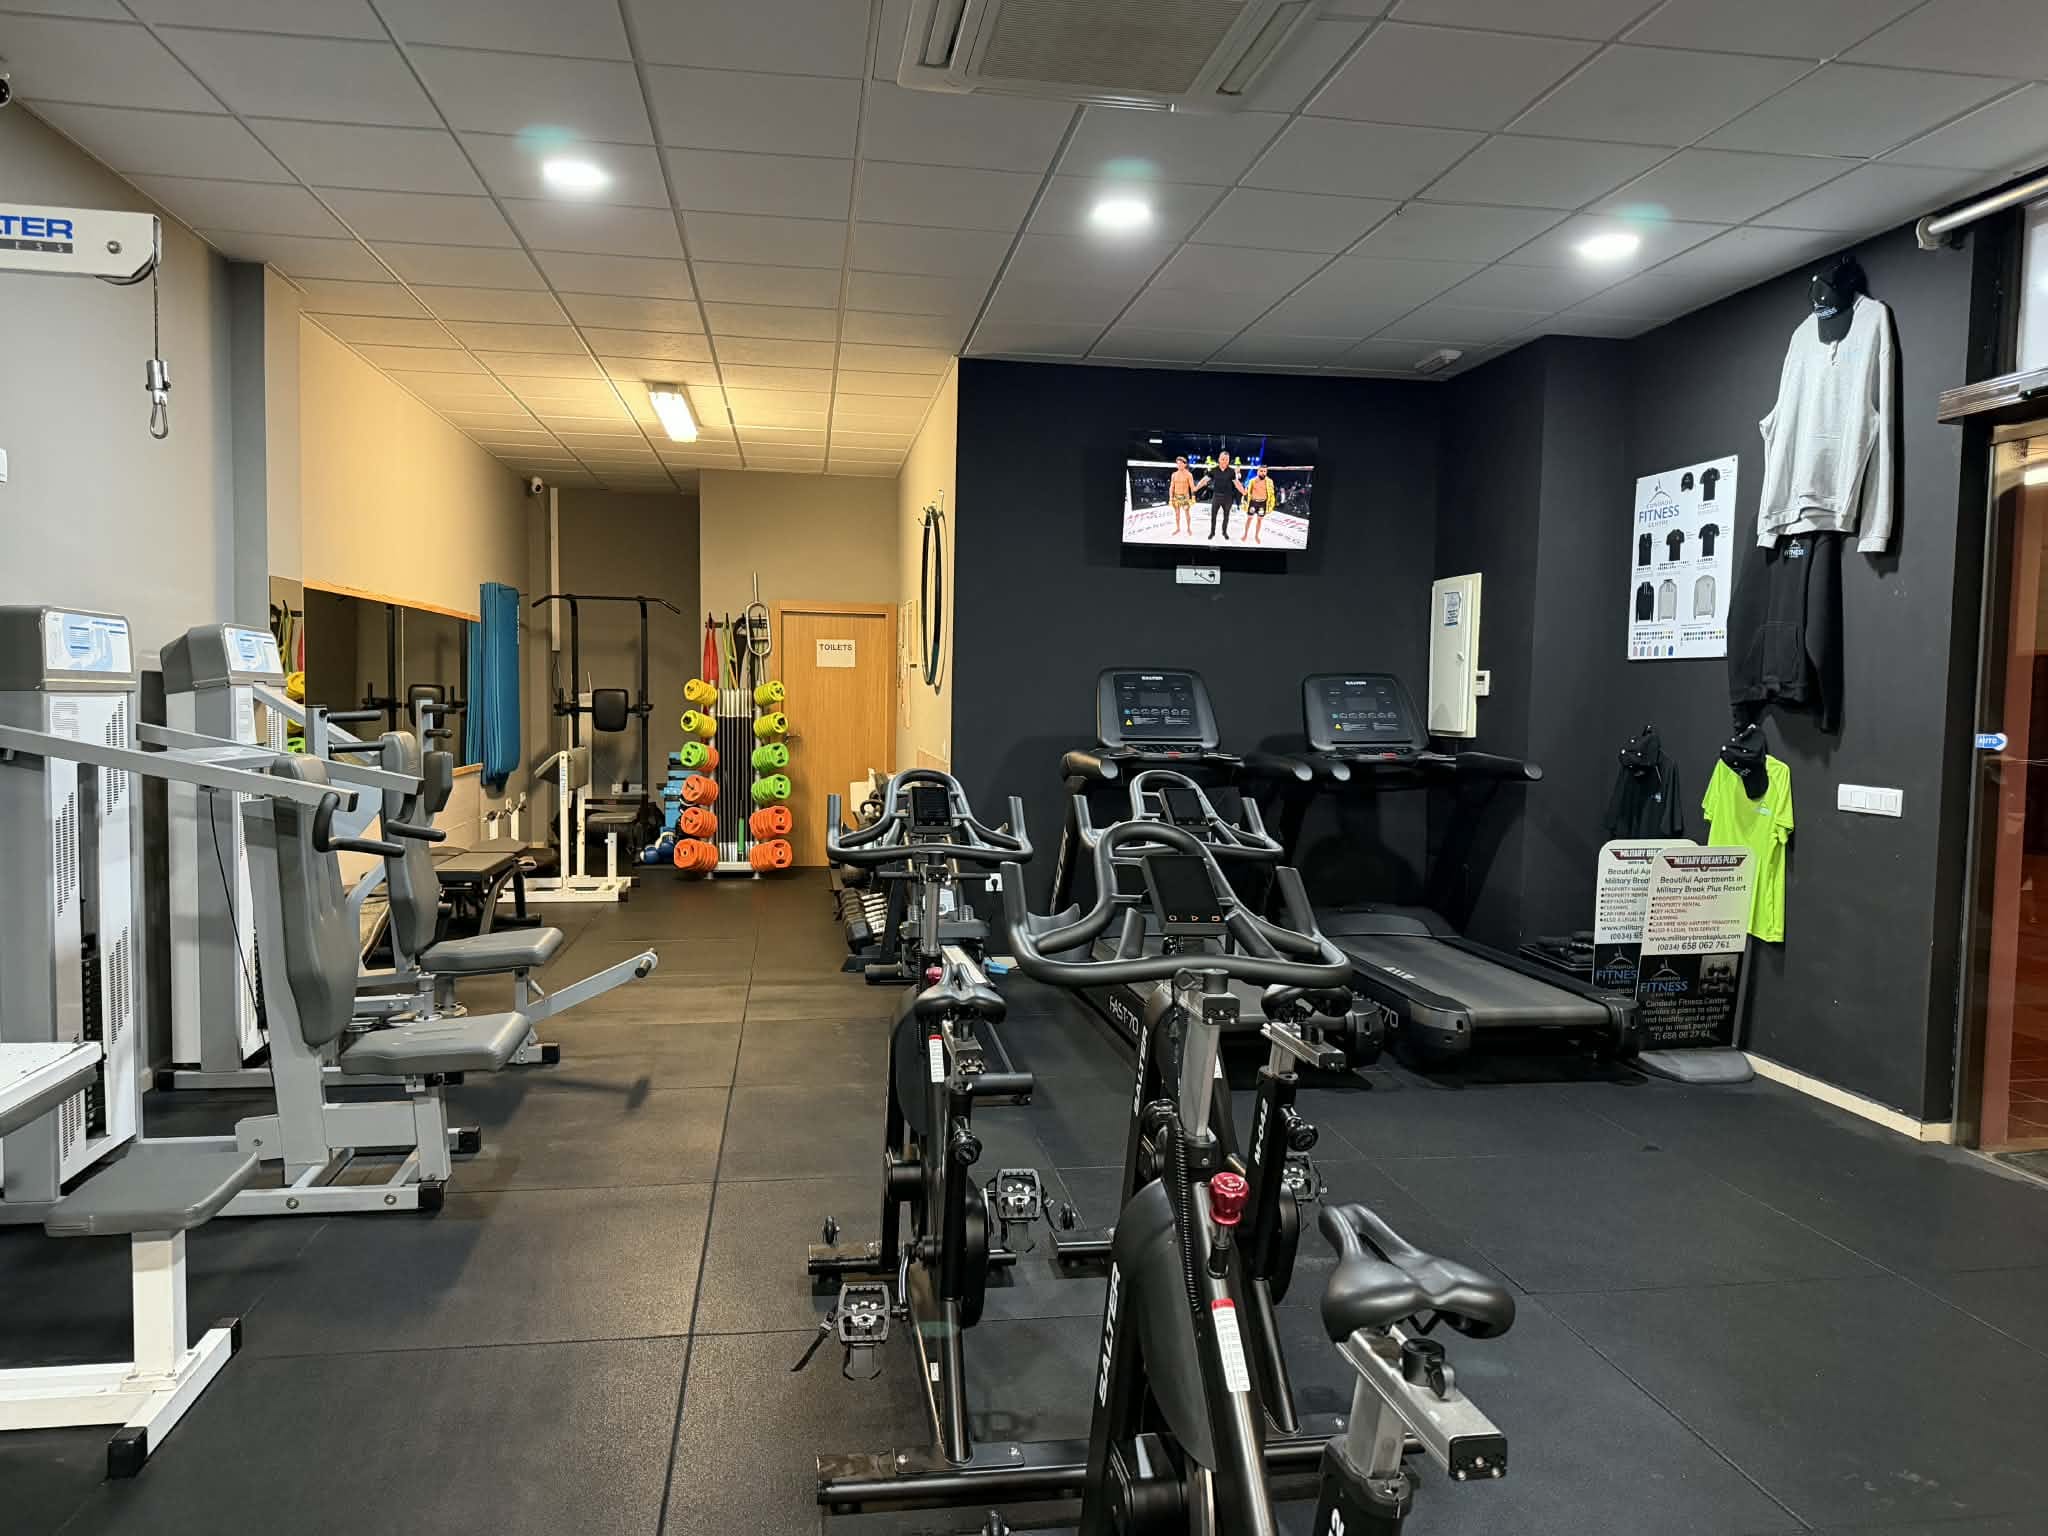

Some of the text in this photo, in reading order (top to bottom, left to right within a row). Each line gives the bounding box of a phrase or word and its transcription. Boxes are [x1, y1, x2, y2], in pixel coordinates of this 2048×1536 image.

[0, 215, 73, 239] TER
[1638, 504, 1680, 525] FITNESS
[819, 643, 853, 651] TOILETS
[1674, 855, 1737, 865] MILITARY BREAKS PLUS
[1605, 877, 1631, 885] Military
[1660, 876, 1692, 884] Beautiful
[1694, 876, 1735, 884] Apartments
[1657, 886, 1683, 895] Military
[1723, 884, 1747, 892] Resort
[1648, 933, 1741, 942] www.militarybreaksplus.com
[1682, 942, 1697, 950] 658
[1699, 941, 1713, 950] 062
[1715, 941, 1730, 949] 761
[1640, 981, 1689, 993] FITNESS
[1133, 1024, 1148, 1117] SALTER
[1098, 1261, 1121, 1408] SALTER
